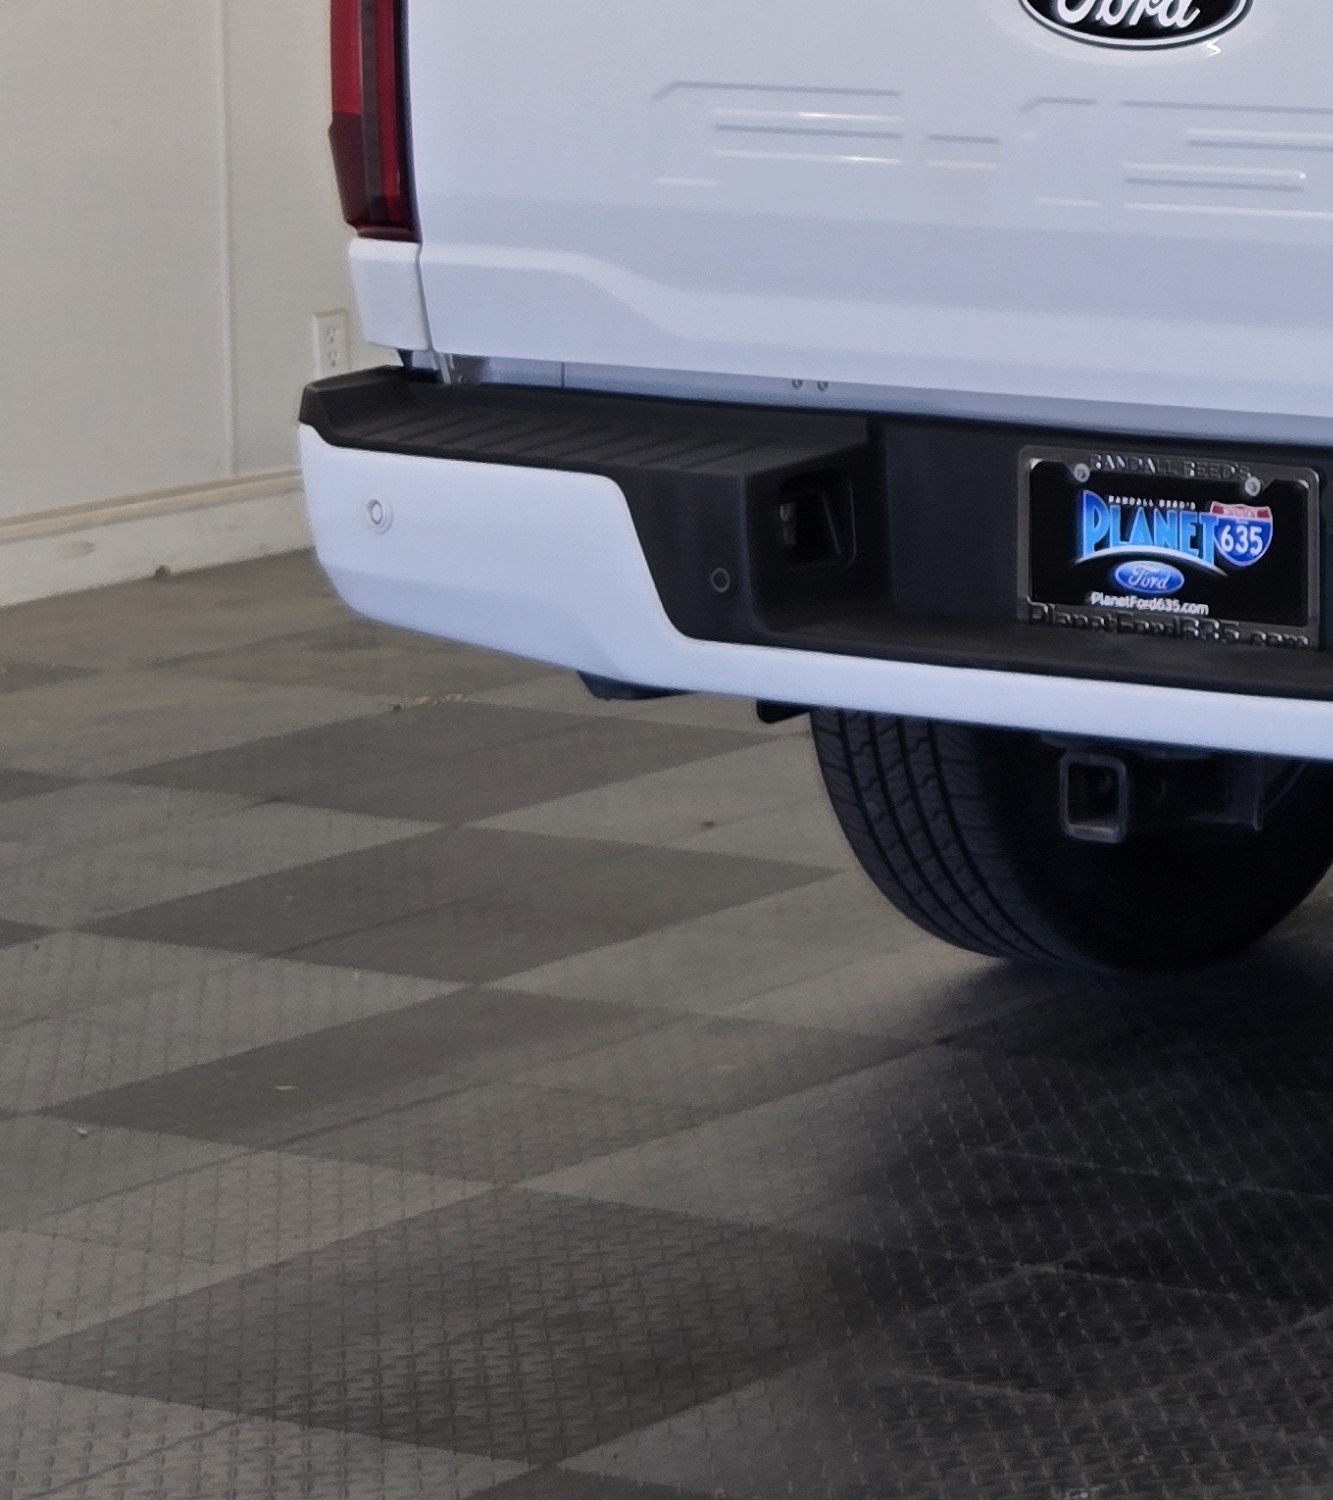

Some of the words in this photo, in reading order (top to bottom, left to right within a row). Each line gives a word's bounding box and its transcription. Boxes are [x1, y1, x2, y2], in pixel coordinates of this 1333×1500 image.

[1090, 454, 1179, 477] RANDALL
[1083, 489, 1220, 566] PLANET
[1220, 524, 1264, 557] 635
[1127, 563, 1170, 592] Ford
